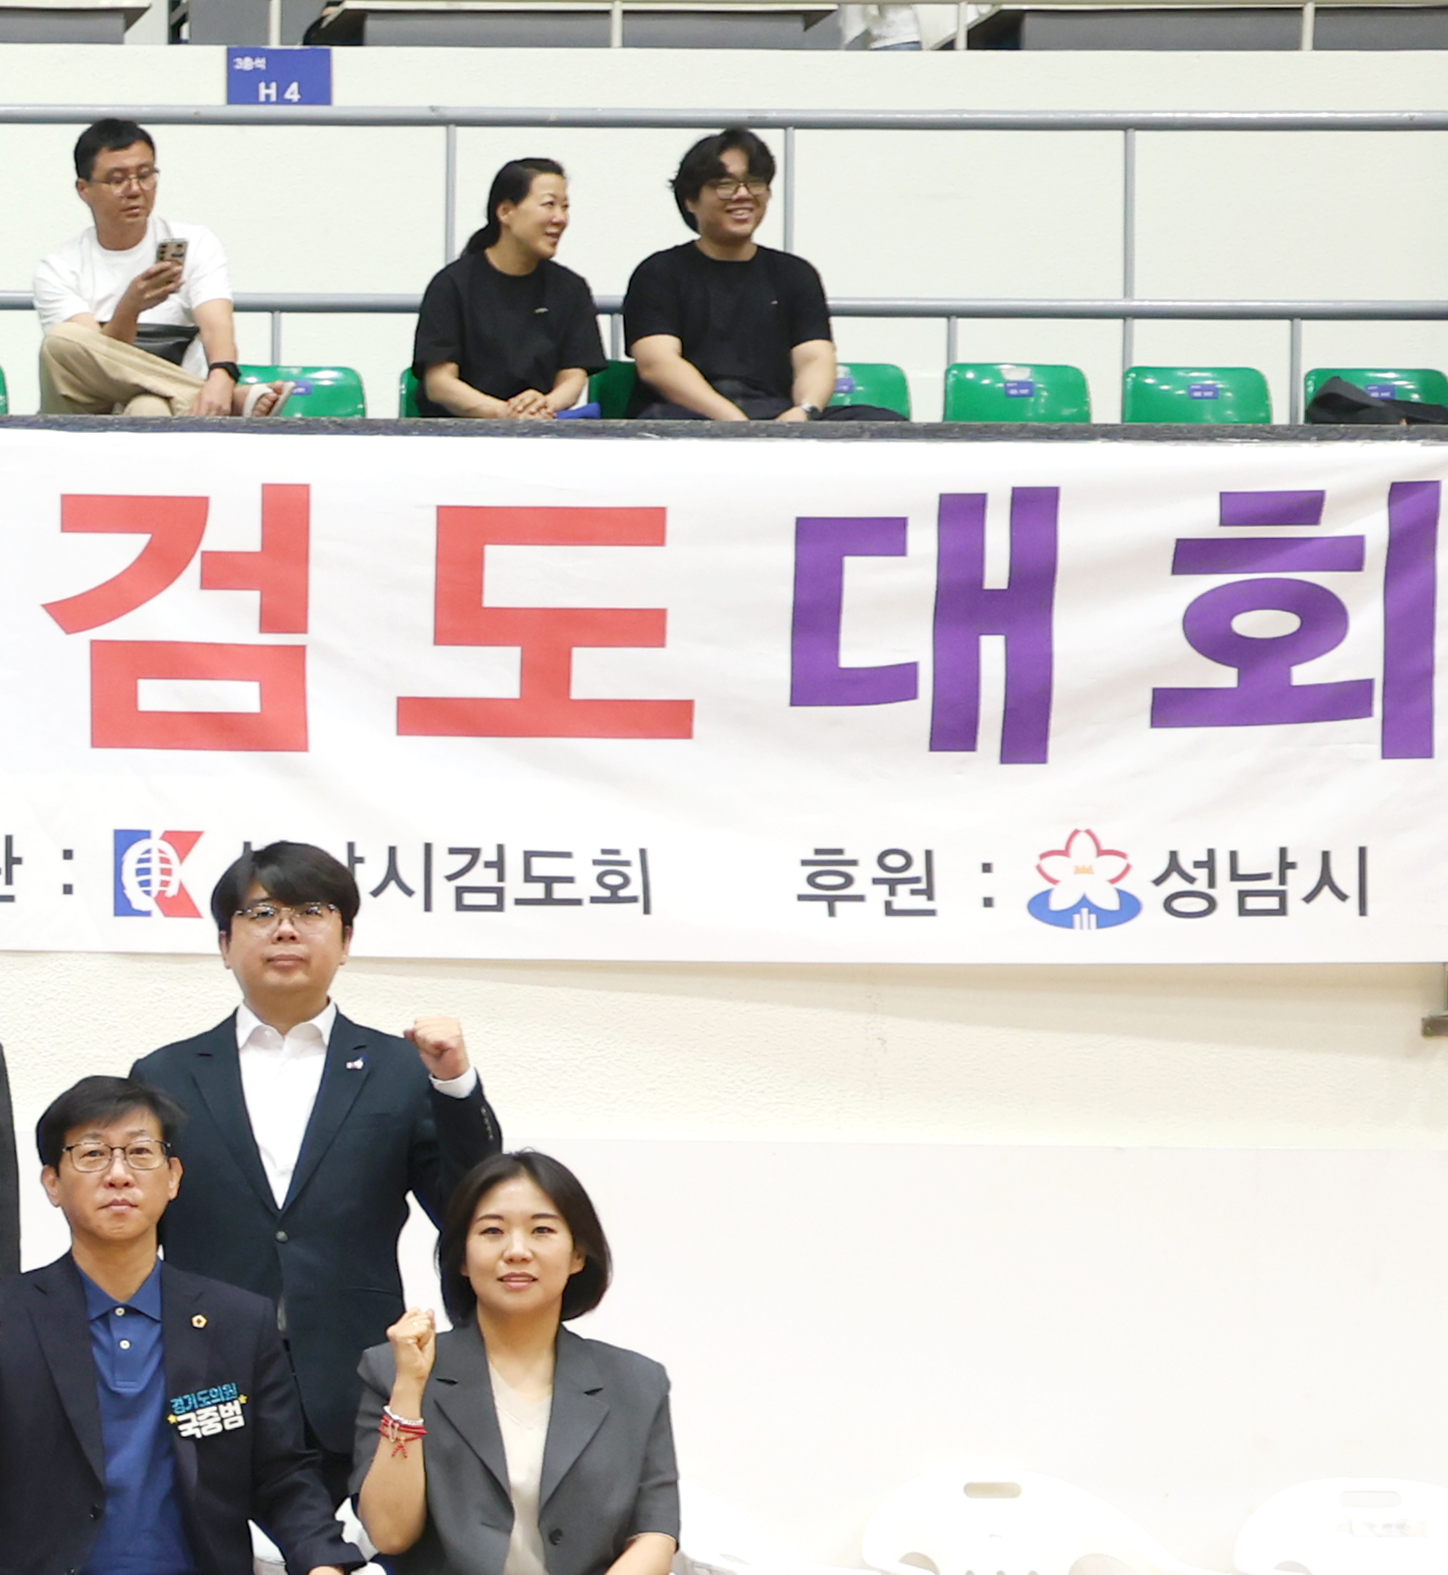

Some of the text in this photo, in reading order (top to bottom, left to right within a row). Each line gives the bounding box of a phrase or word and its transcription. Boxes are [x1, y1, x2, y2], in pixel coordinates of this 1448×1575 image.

[258, 81, 301, 103] H 4
[243, 841, 652, 915] 시검도회
[796, 848, 938, 918] 후원
[1152, 846, 1369, 918] 성남시
[169, 1381, 240, 1415] 경기도의원
[176, 1399, 246, 1440] 국중범
